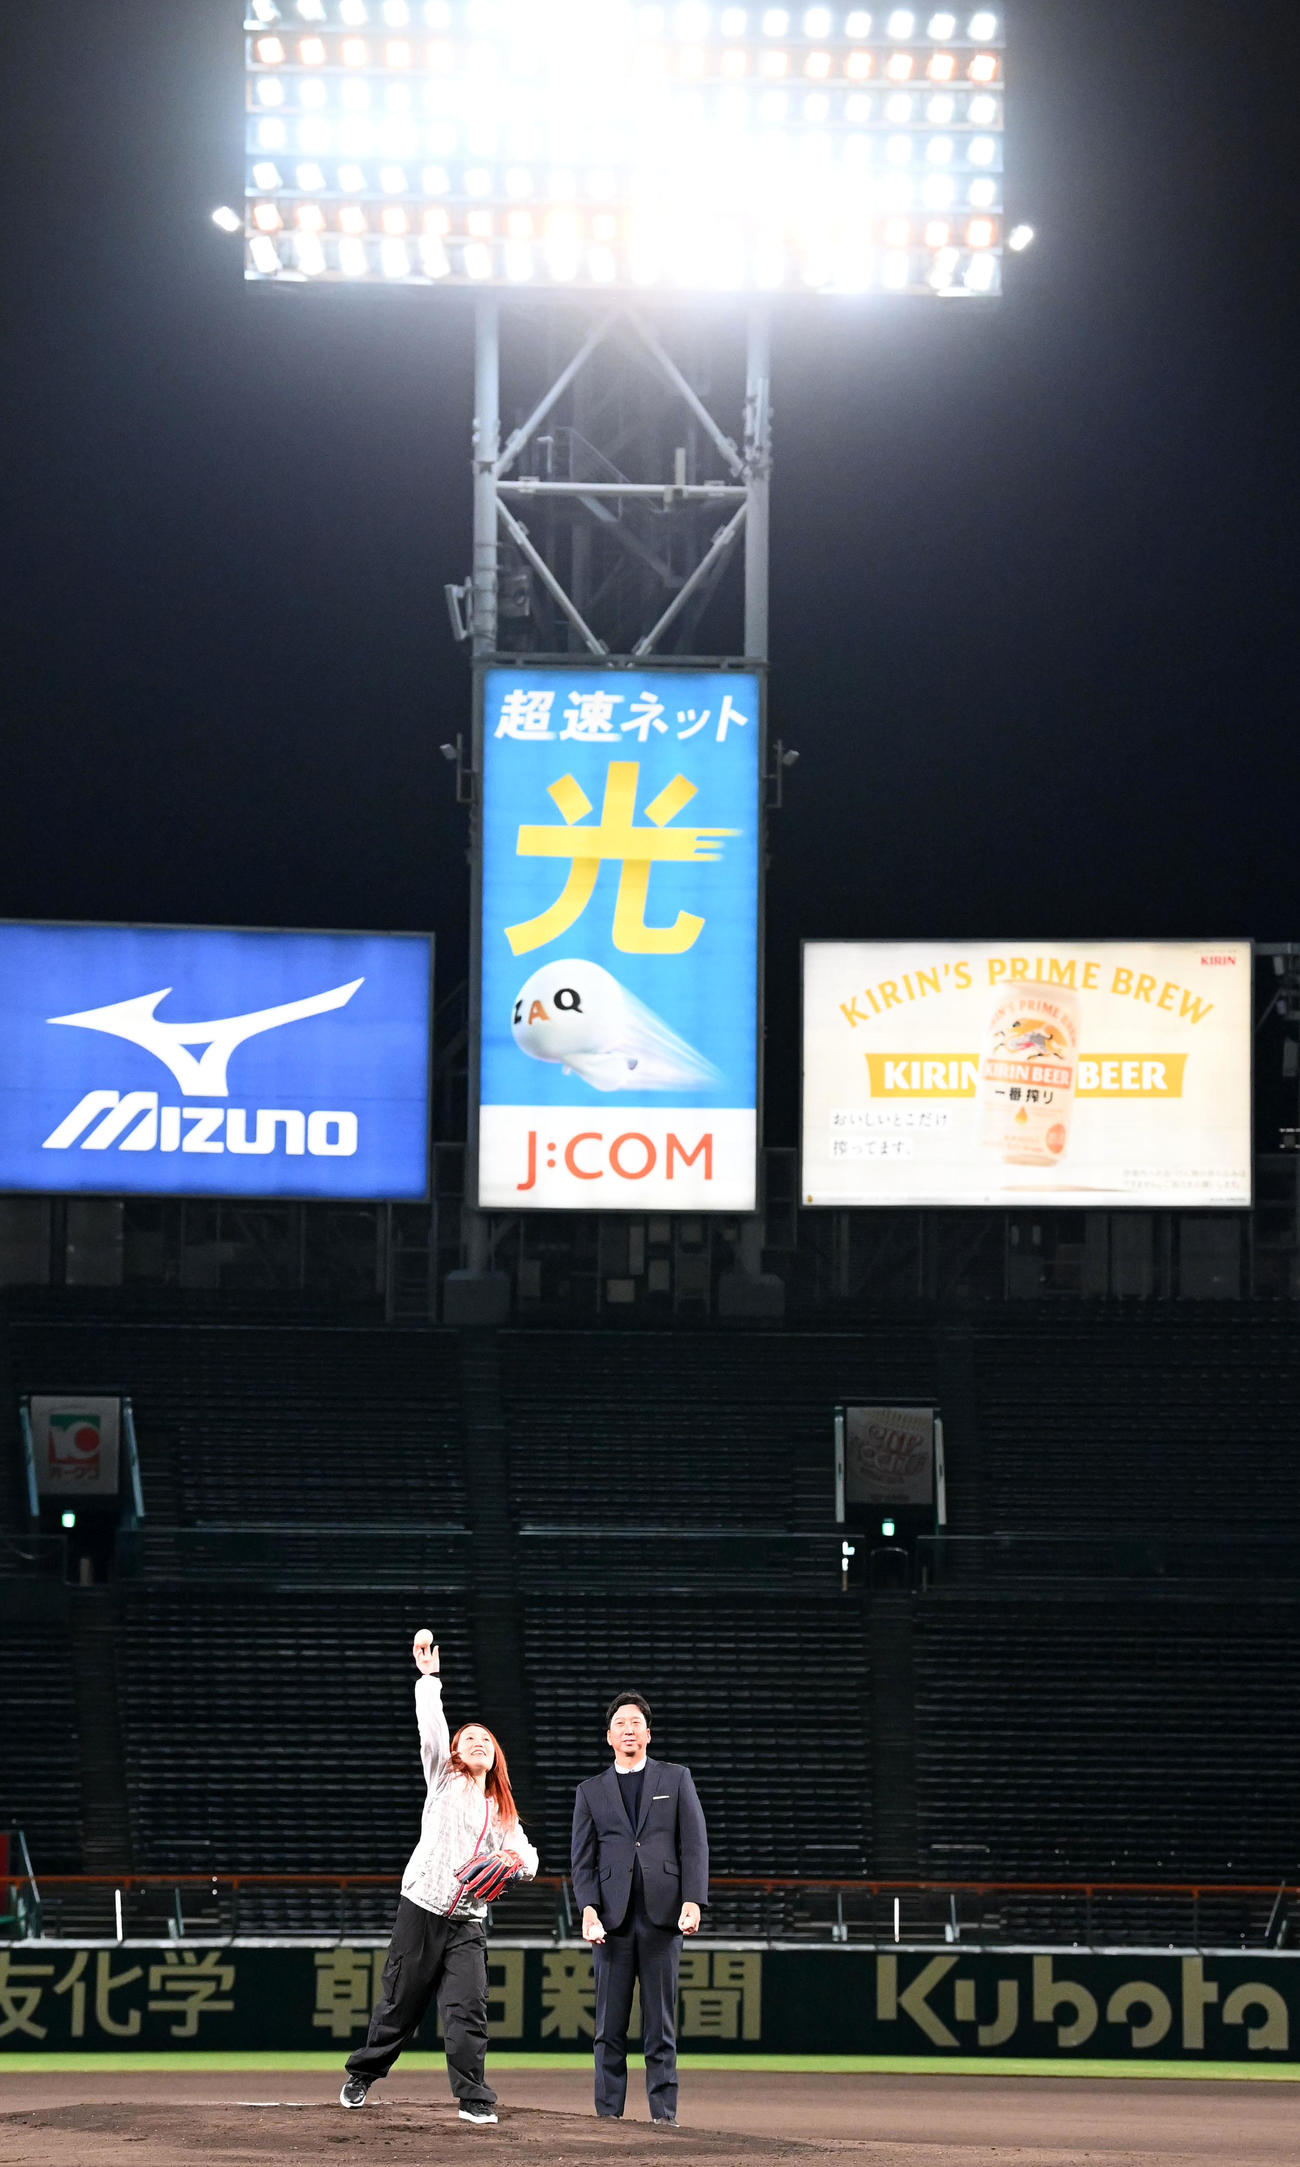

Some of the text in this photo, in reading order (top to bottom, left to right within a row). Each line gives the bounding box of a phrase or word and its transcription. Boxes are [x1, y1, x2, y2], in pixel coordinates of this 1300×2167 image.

[494, 688, 749, 743] 超速ネット
[503, 760, 743, 957] 光
[1200, 955, 1236, 967] KIRIN
[839, 957, 1215, 1029] KIRIN'S PRIME BREW
[884, 1060, 1168, 1091] KIRIN BEER
[1032, 1066, 1070, 1085] BEER
[833, 1111, 948, 1128] おいしいとこだけ
[516, 1131, 714, 1191] J:COM
[876, 1955, 1289, 2051] Kubota
